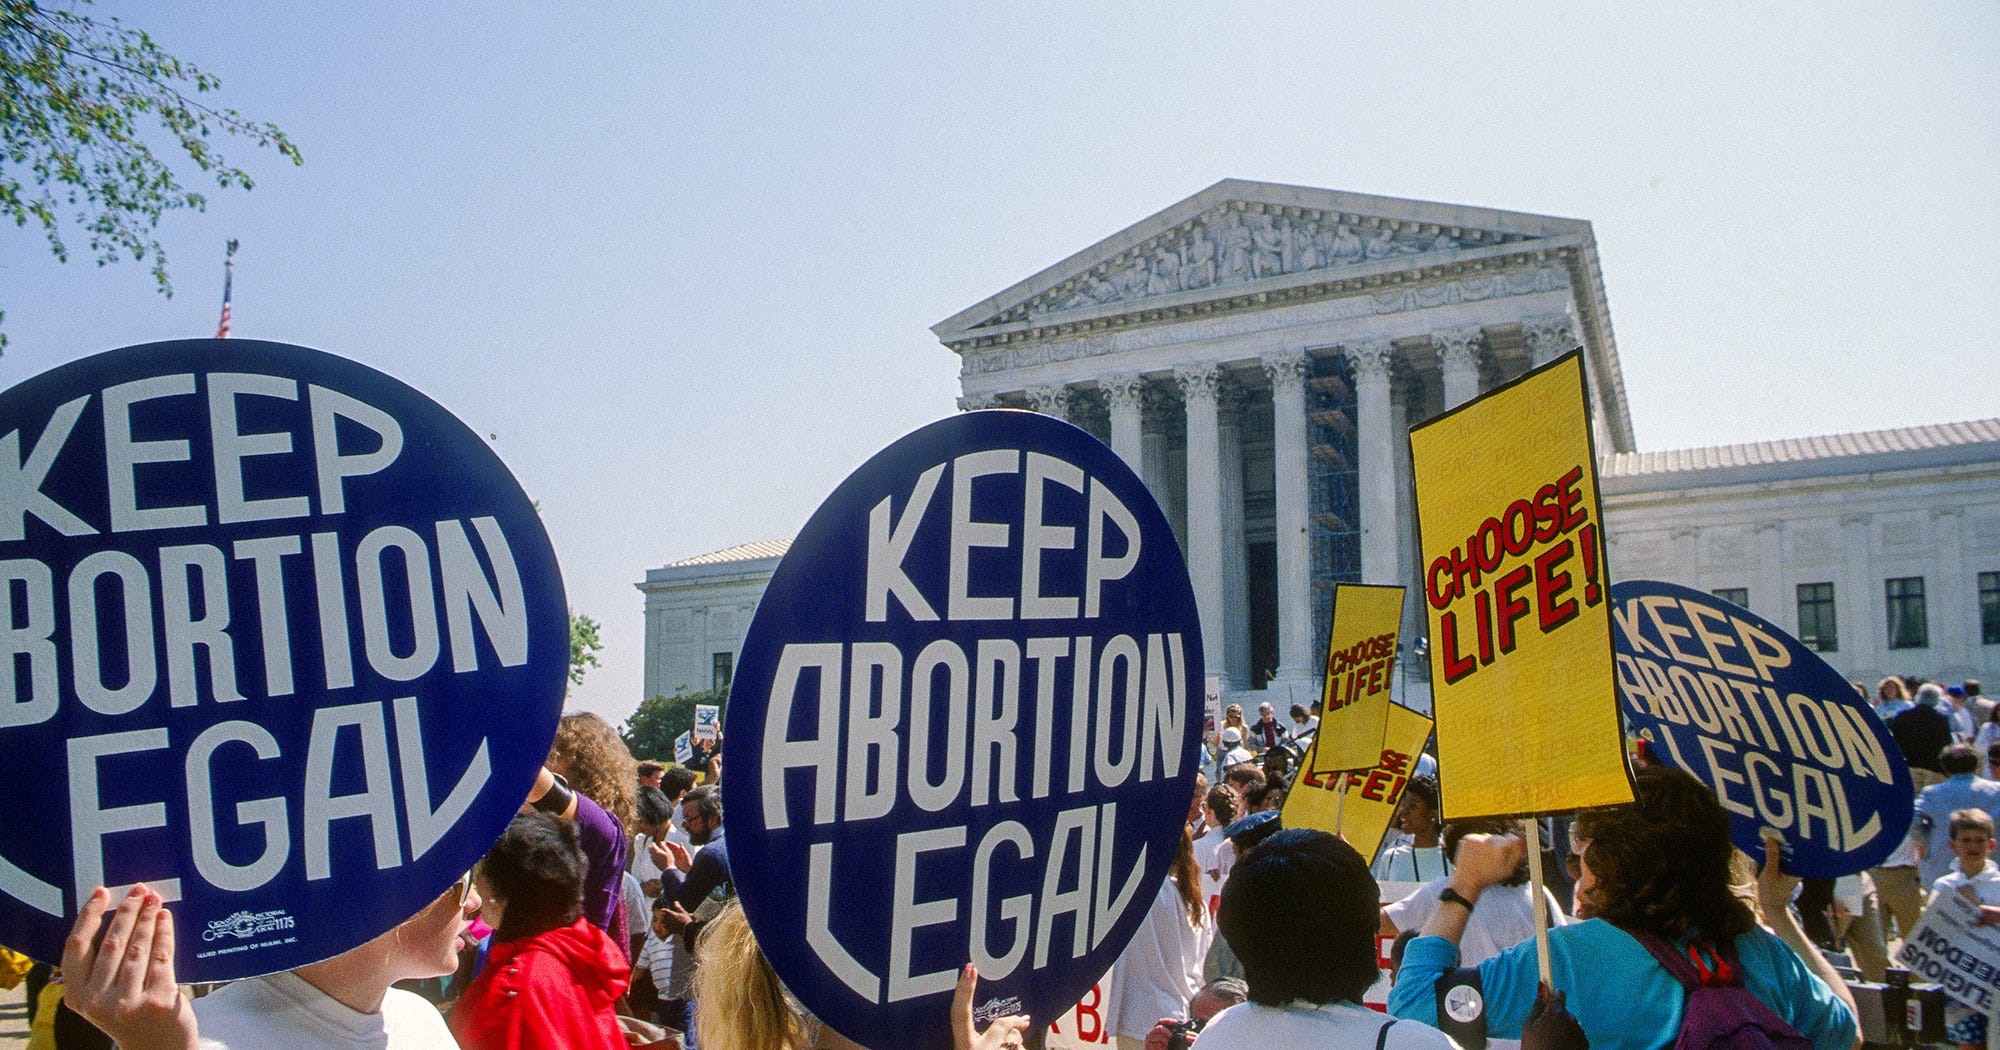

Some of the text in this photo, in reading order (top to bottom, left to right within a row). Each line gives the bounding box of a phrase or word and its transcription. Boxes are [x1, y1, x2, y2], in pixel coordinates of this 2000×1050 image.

[0, 372, 403, 541] KEEP
[866, 450, 1141, 622] KEEP
[1427, 465, 1588, 610] CHOOSE
[0, 516, 527, 728] BORTION
[1329, 632, 1395, 676] CHOOSE
[1441, 523, 1603, 685] LIFE!
[1613, 596, 1791, 682] KEEP
[762, 634, 1185, 829] ABORTION
[1328, 657, 1395, 712] LIFE!
[1617, 653, 1893, 785] ABORTION
[0, 697, 491, 917] EGAL
[1659, 724, 1881, 852] LEGAL
[218, 945, 248, 954] PRINTING
[275, 916, 295, 930] 1175
[806, 803, 1146, 1004] LEGAL
[1917, 926, 2000, 990] REEDOM
[1902, 943, 1991, 1008] LIGIOUS
